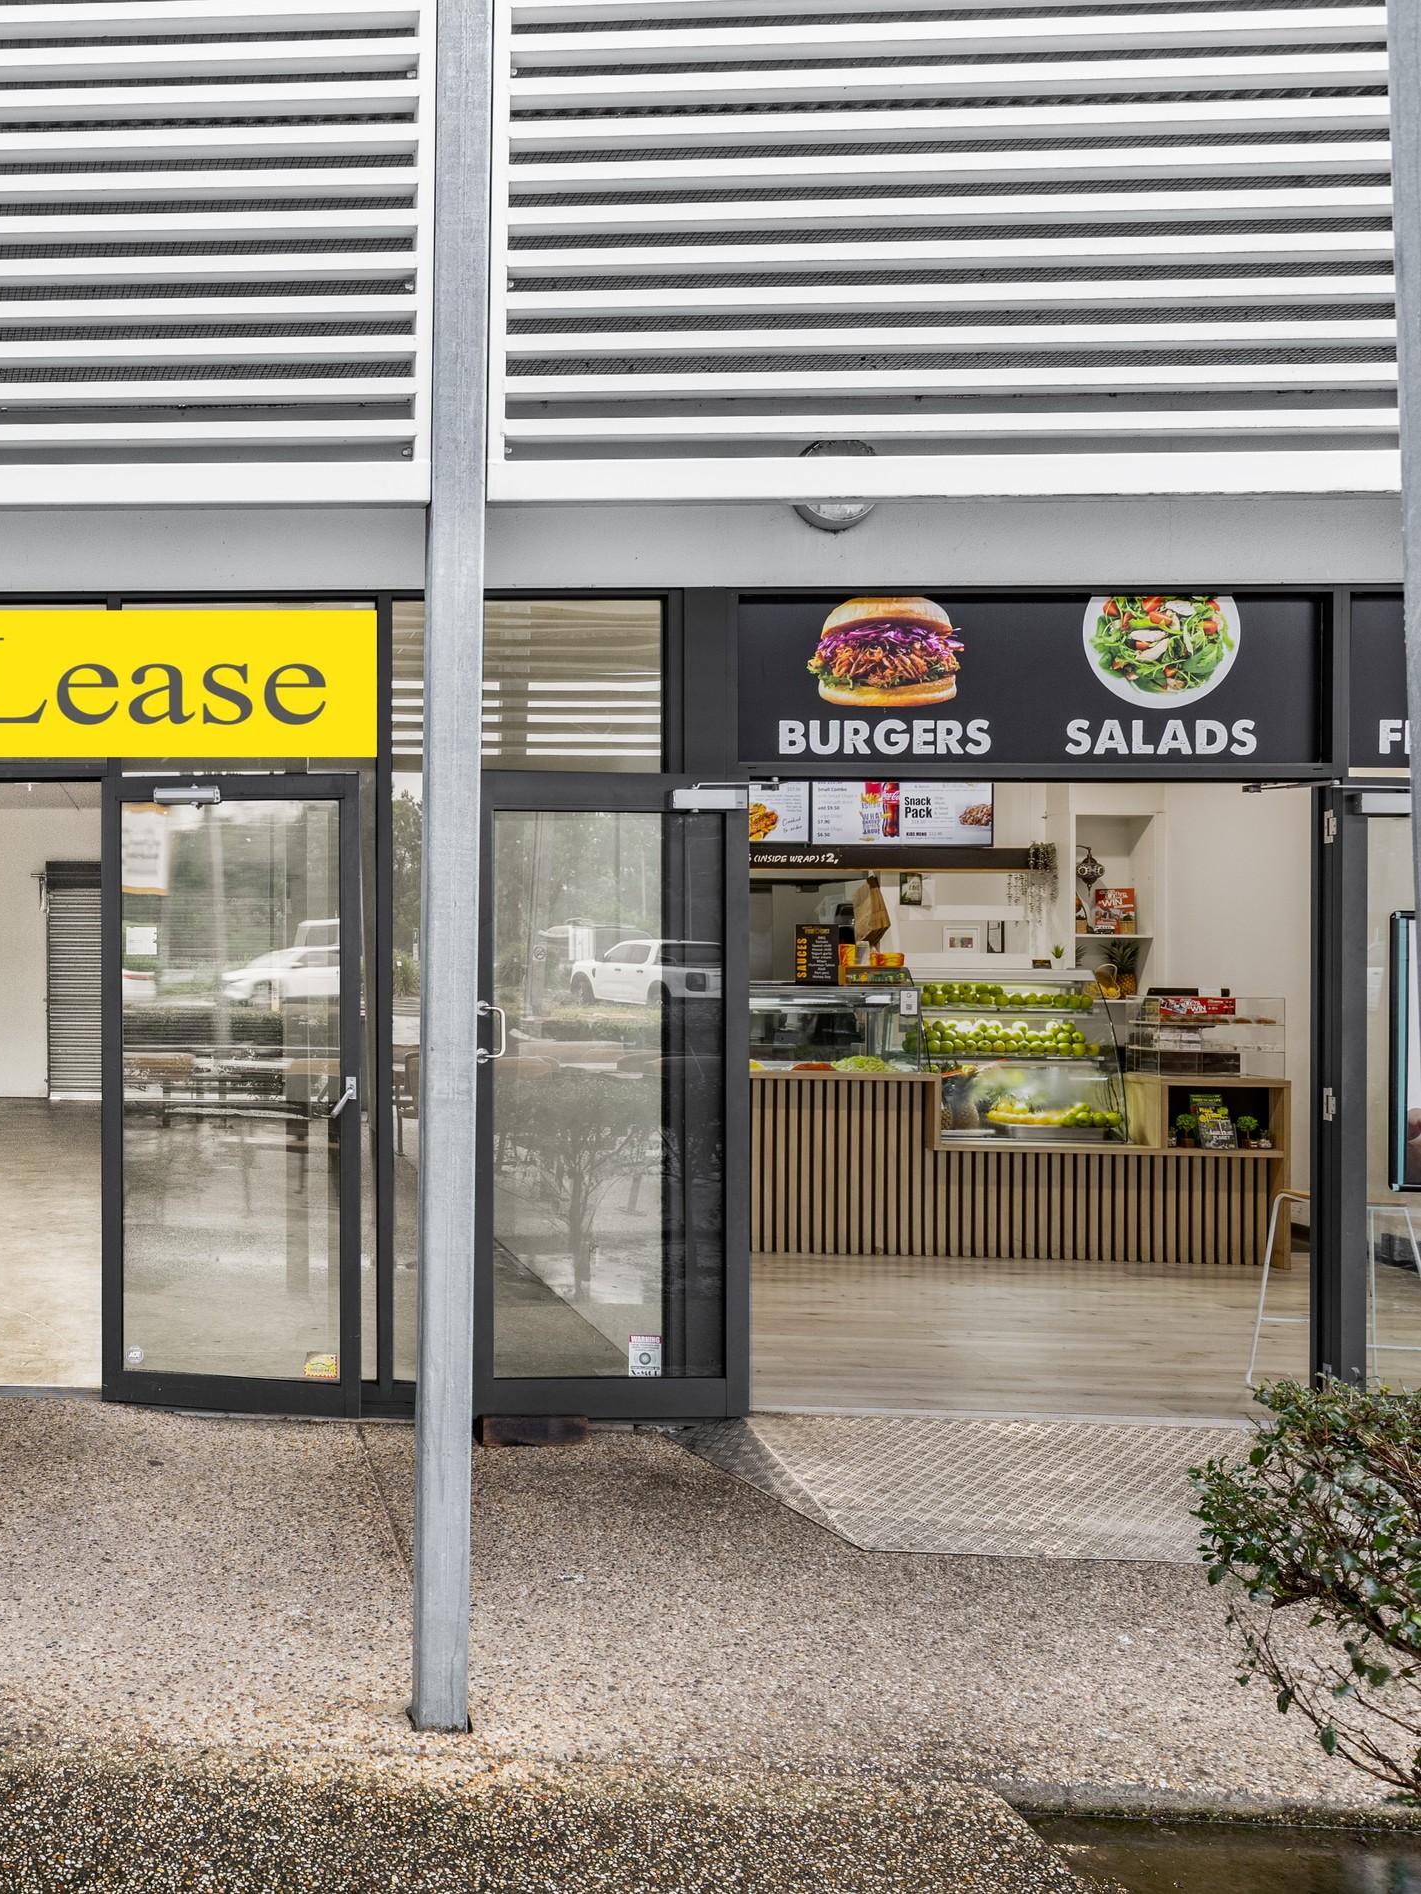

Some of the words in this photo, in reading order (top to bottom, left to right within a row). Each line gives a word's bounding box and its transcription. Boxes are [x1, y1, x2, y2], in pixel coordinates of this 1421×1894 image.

[778, 718, 992, 756] BURGERS
[1065, 718, 1258, 756] SALADS
[904, 796, 932, 806] Snack
[904, 807, 932, 818] Pack
[754, 855, 788, 863] (INSIDE
[790, 855, 819, 863] WRAP)
[797, 938, 807, 978] SAUCES
